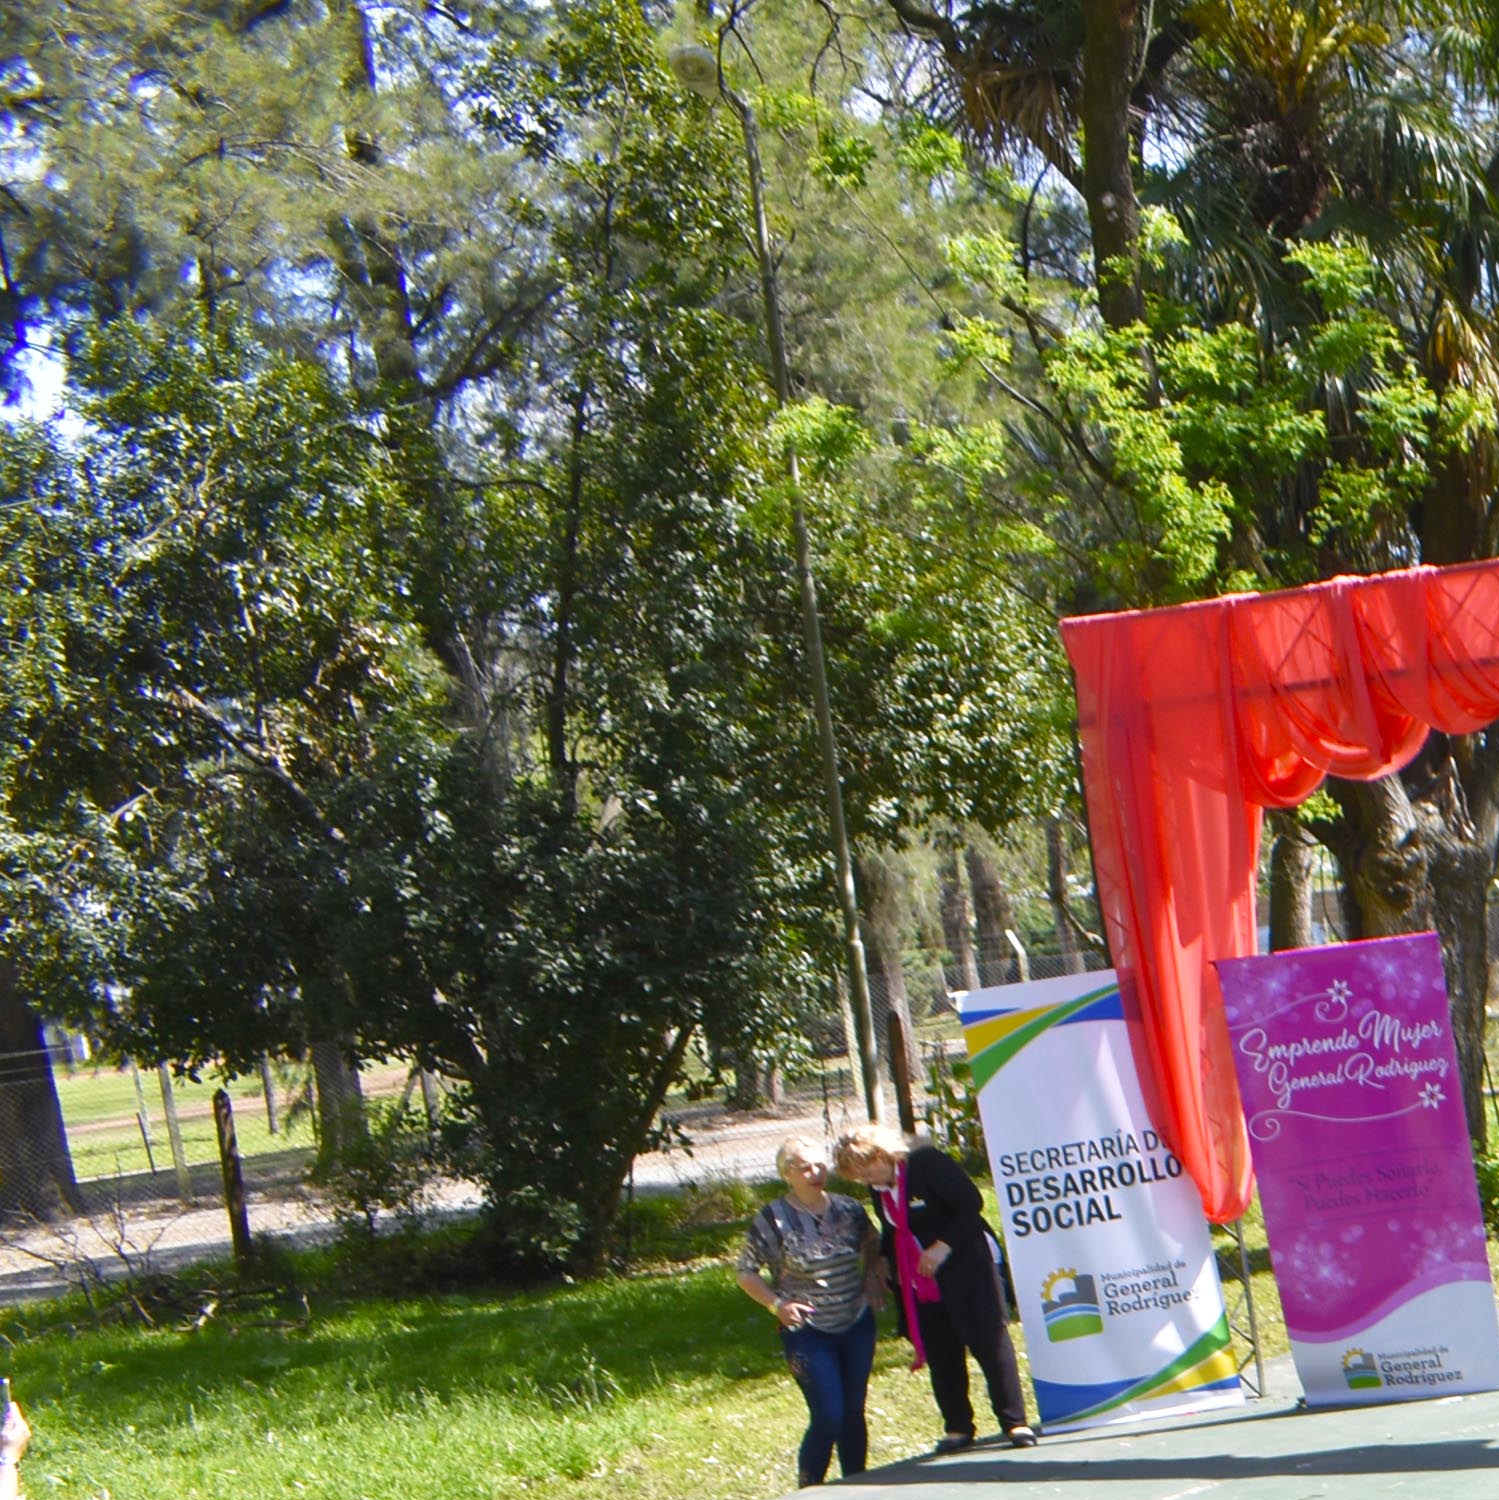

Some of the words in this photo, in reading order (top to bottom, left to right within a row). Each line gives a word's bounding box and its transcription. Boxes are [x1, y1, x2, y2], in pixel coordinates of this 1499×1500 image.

[1239, 1028, 1360, 1072] Emprende
[1358, 1010, 1444, 1052] Mujer
[1268, 1061, 1345, 1109] General
[1000, 1128, 1140, 1177] SECRETARÍA
[1142, 1128, 1168, 1151] D
[1006, 1154, 1183, 1207] DESARROLLO
[1012, 1195, 1122, 1237] SOCIAL
[1100, 1260, 1173, 1281] Municipalidad
[1174, 1260, 1187, 1269] de
[1104, 1270, 1179, 1299] General
[1377, 1346, 1437, 1360] Municipalidad
[1439, 1345, 1449, 1354] de
[1380, 1354, 1442, 1373] General
